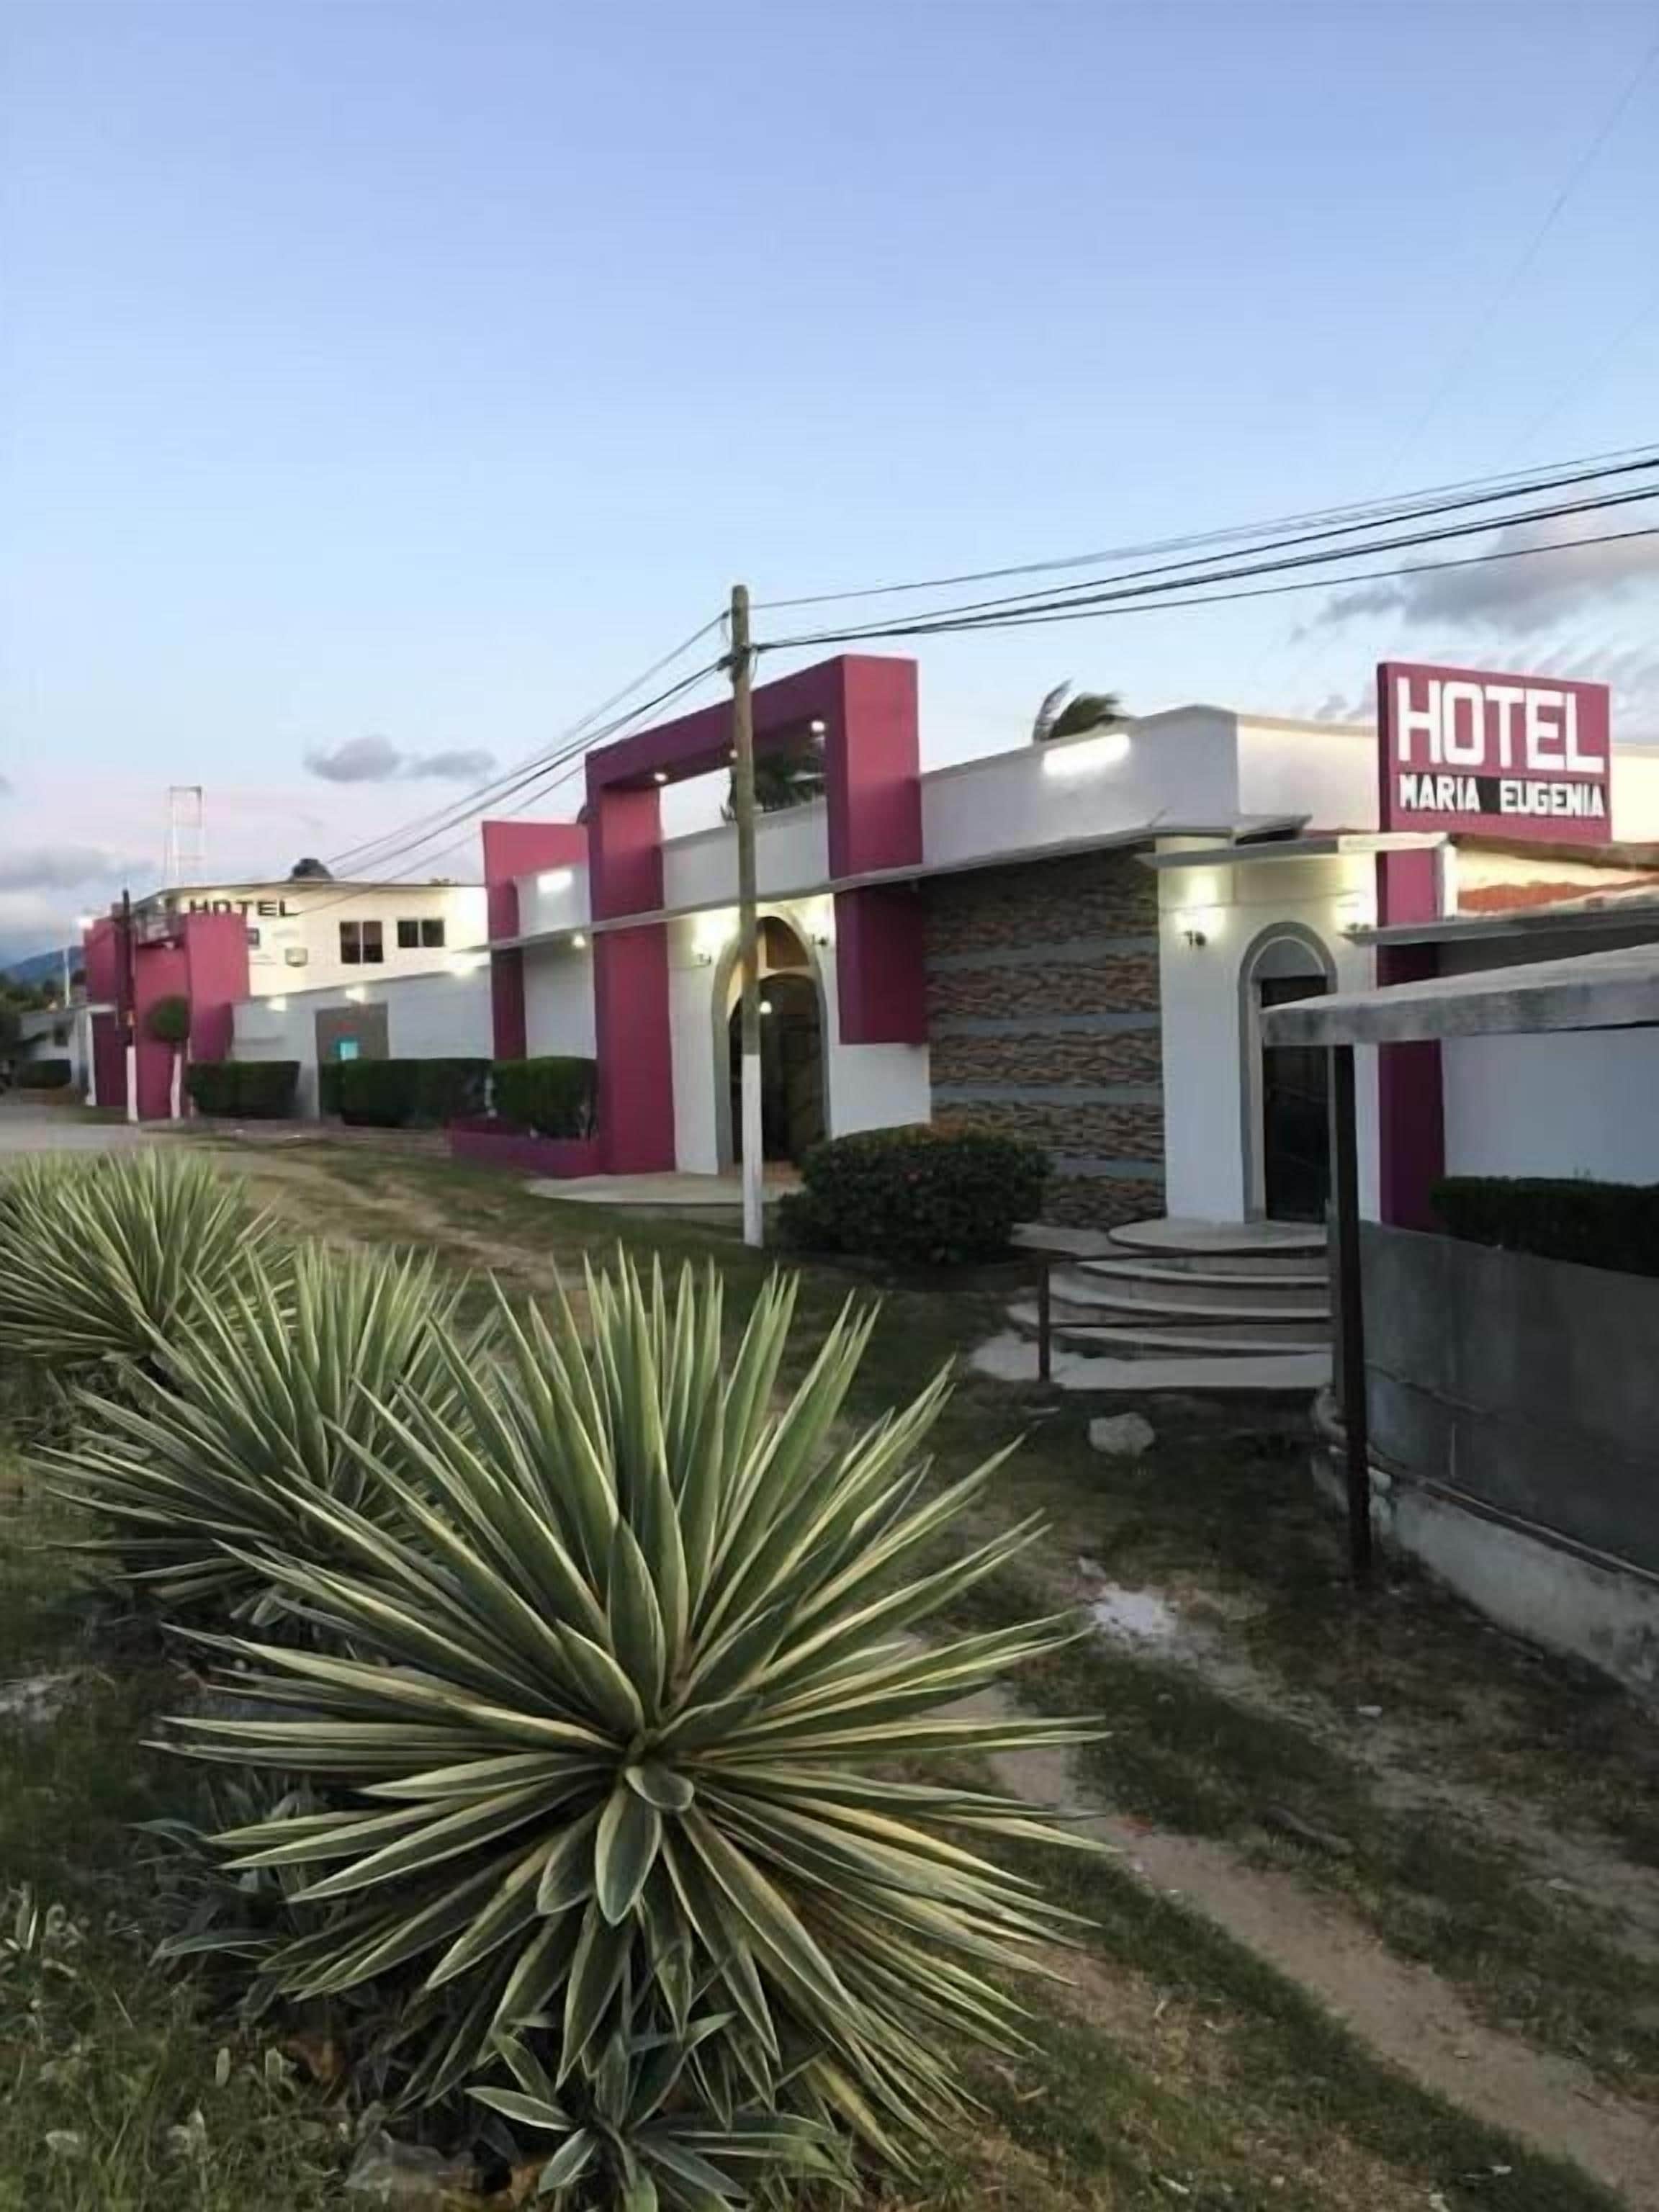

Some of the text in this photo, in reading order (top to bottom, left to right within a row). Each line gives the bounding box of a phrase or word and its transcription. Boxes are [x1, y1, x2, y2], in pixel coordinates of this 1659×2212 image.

[1397, 677, 1604, 773] HOTEL
[1399, 773, 1604, 818] MARIA EUGENIA
[189, 899, 298, 916] HOTEL
